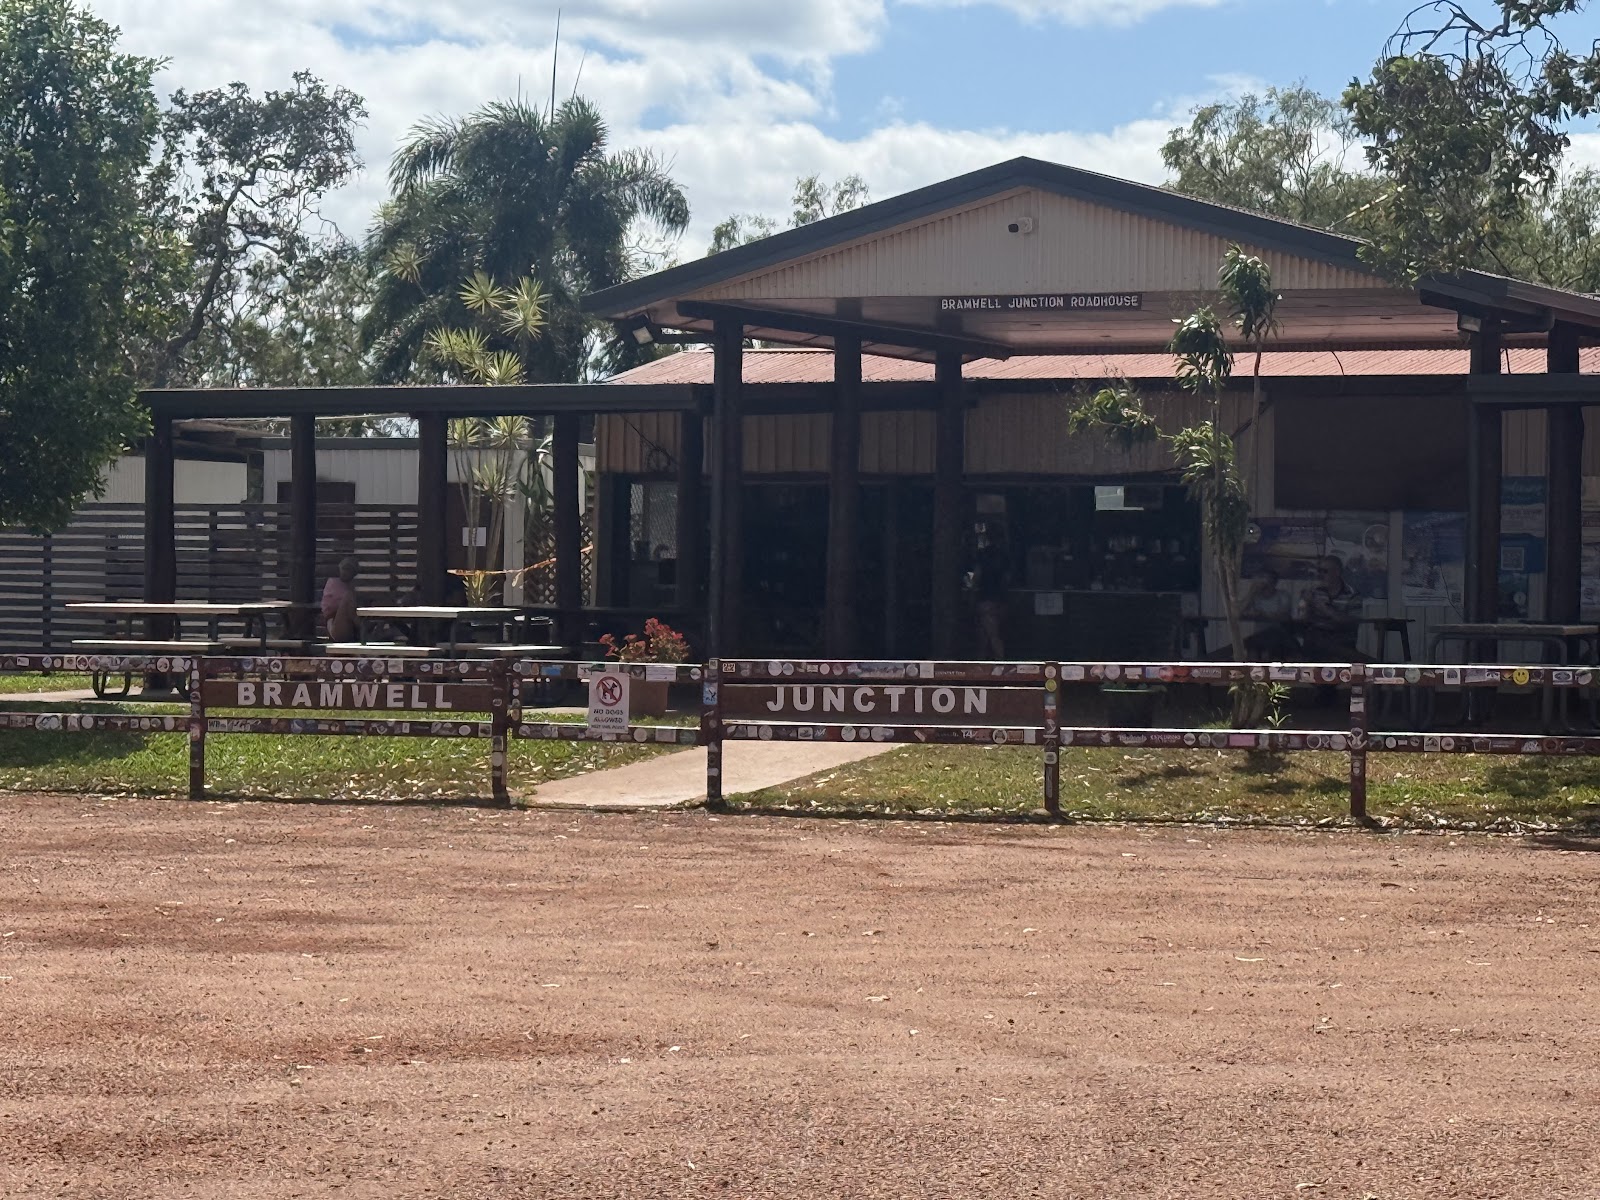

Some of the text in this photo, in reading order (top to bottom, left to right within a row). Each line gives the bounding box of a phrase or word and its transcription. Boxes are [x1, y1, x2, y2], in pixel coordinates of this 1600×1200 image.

[941, 295, 1139, 310] BRAMWELL JUNCTION ROADHOUSE
[237, 682, 452, 709] BRAMWELL
[766, 686, 987, 714] JUNCTION
[605, 708, 624, 716] DOGS
[593, 716, 623, 724] ALLOWED
